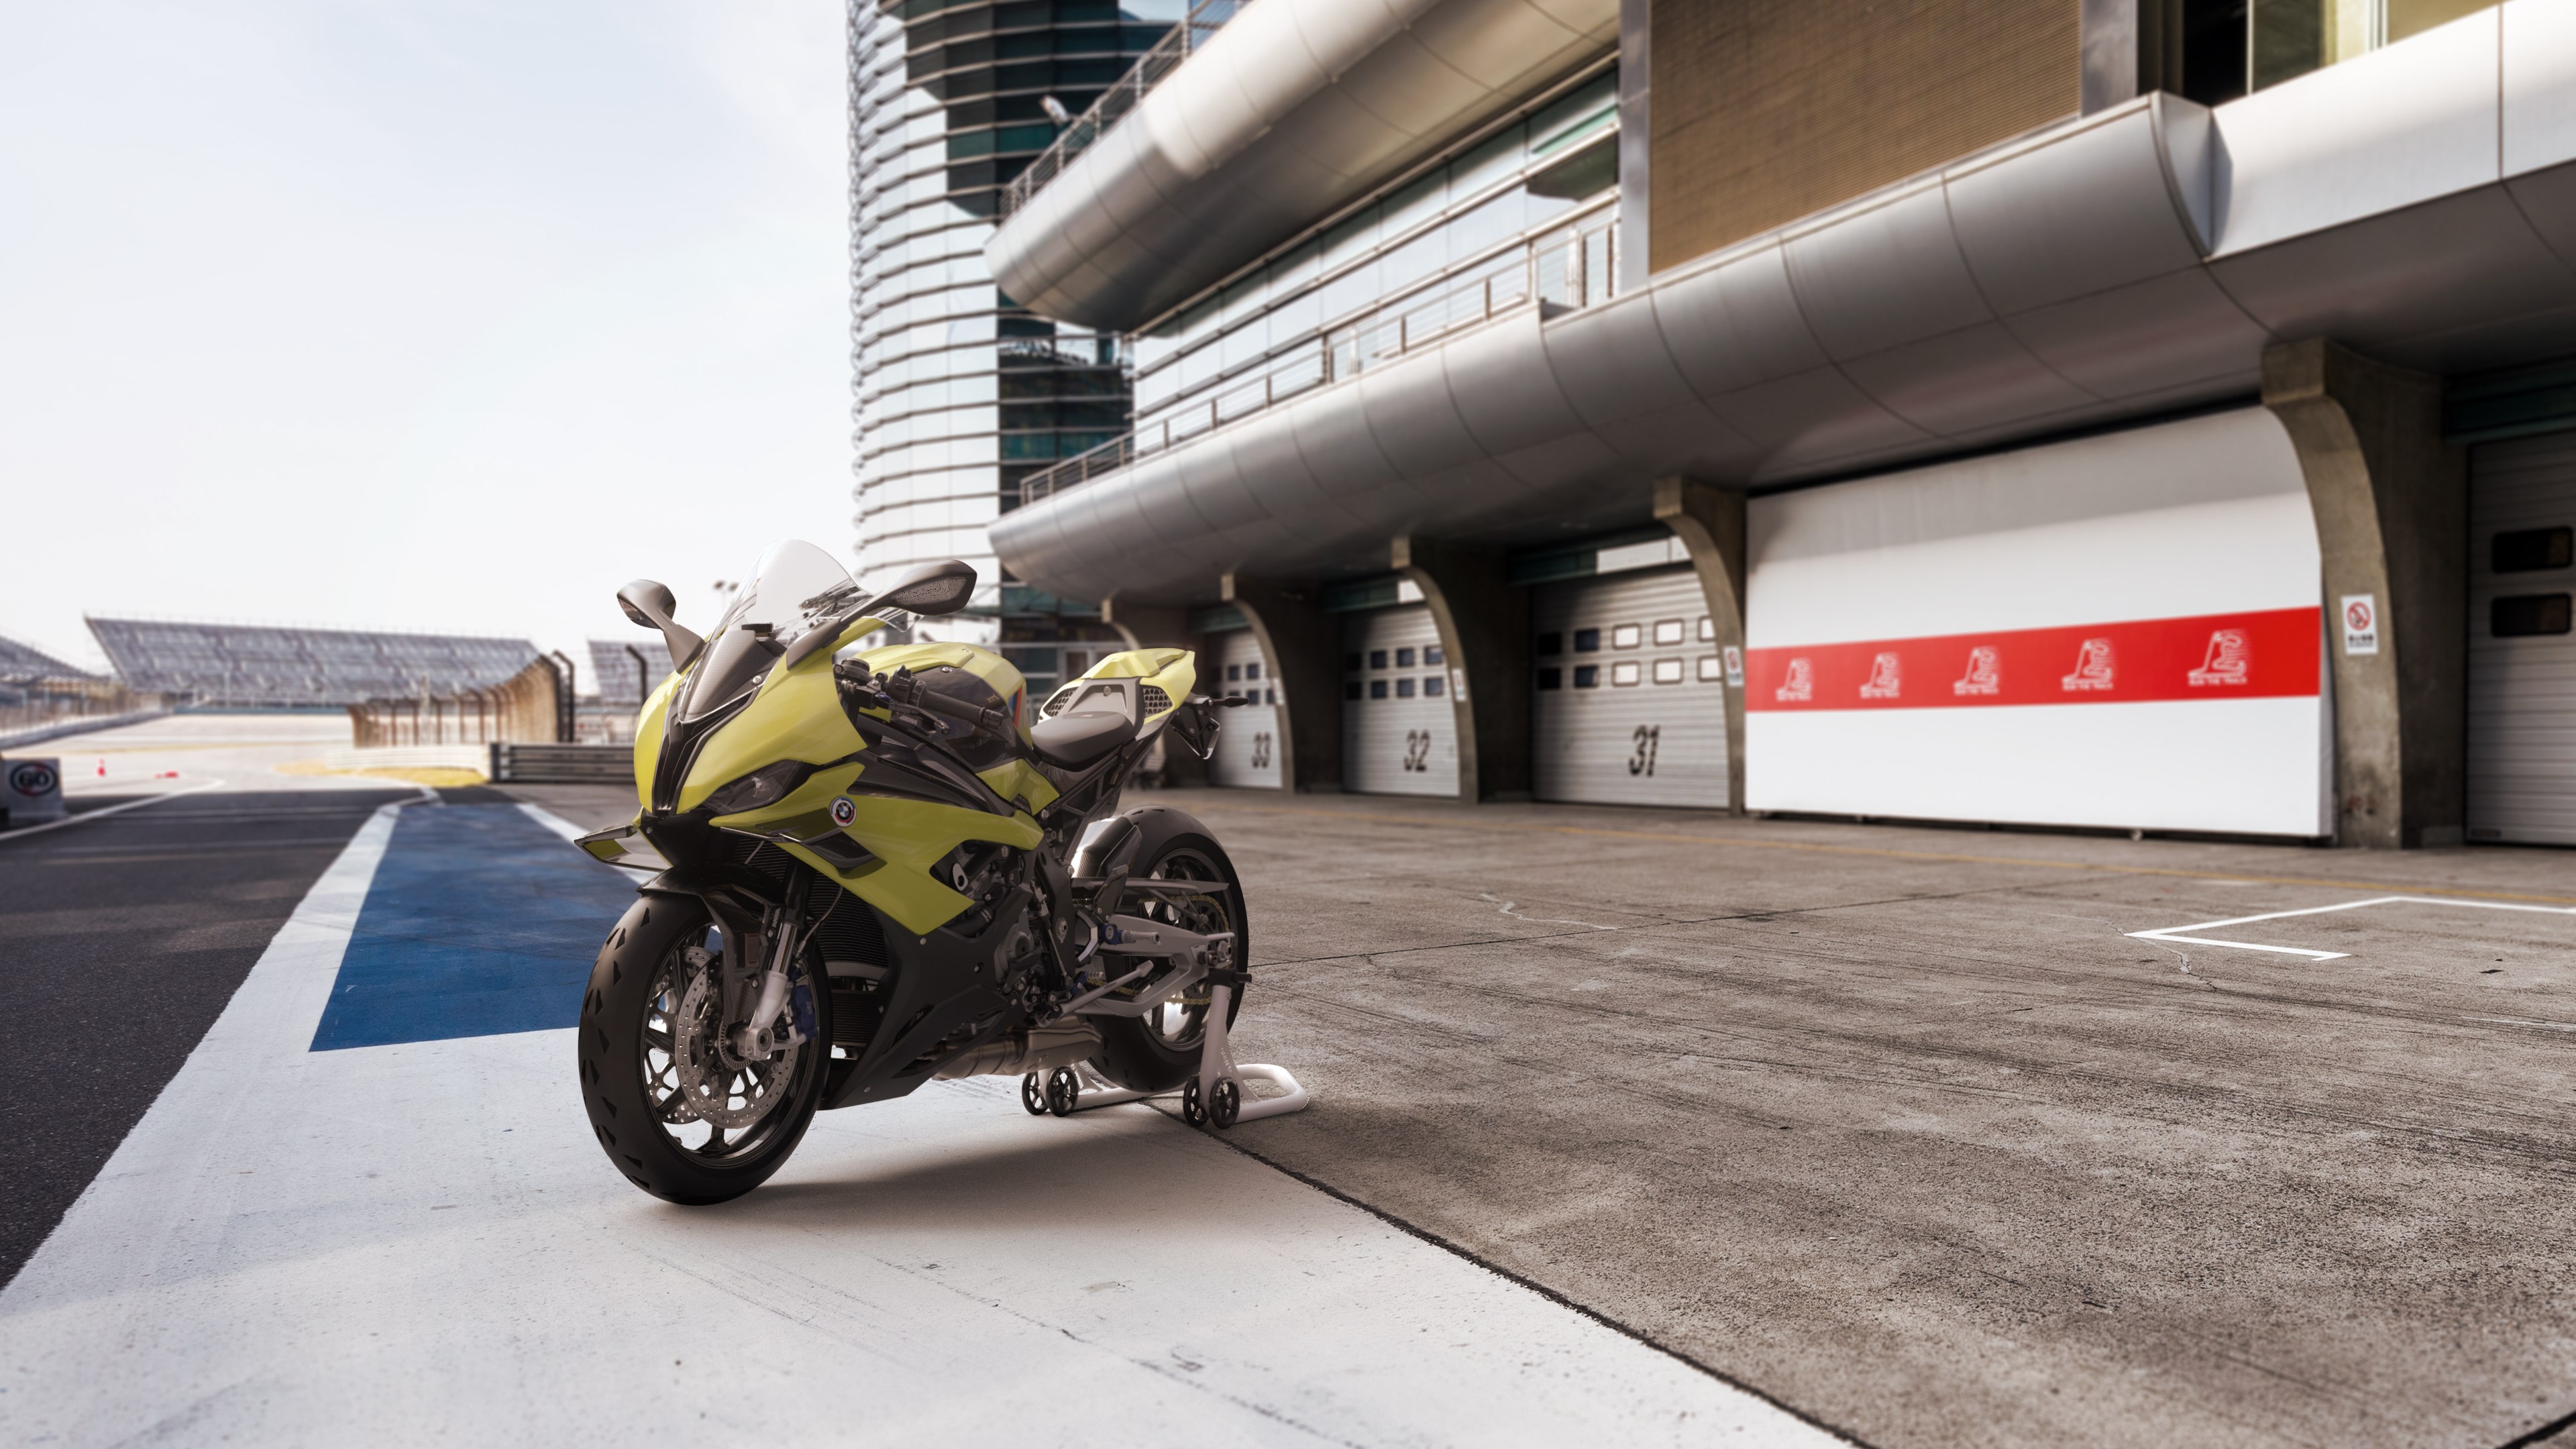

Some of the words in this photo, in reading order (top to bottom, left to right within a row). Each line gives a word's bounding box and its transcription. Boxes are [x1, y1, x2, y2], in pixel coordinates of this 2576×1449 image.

[1250, 731, 1272, 769] 33
[1403, 729, 1430, 773] 32
[1628, 724, 1660, 777] 31
